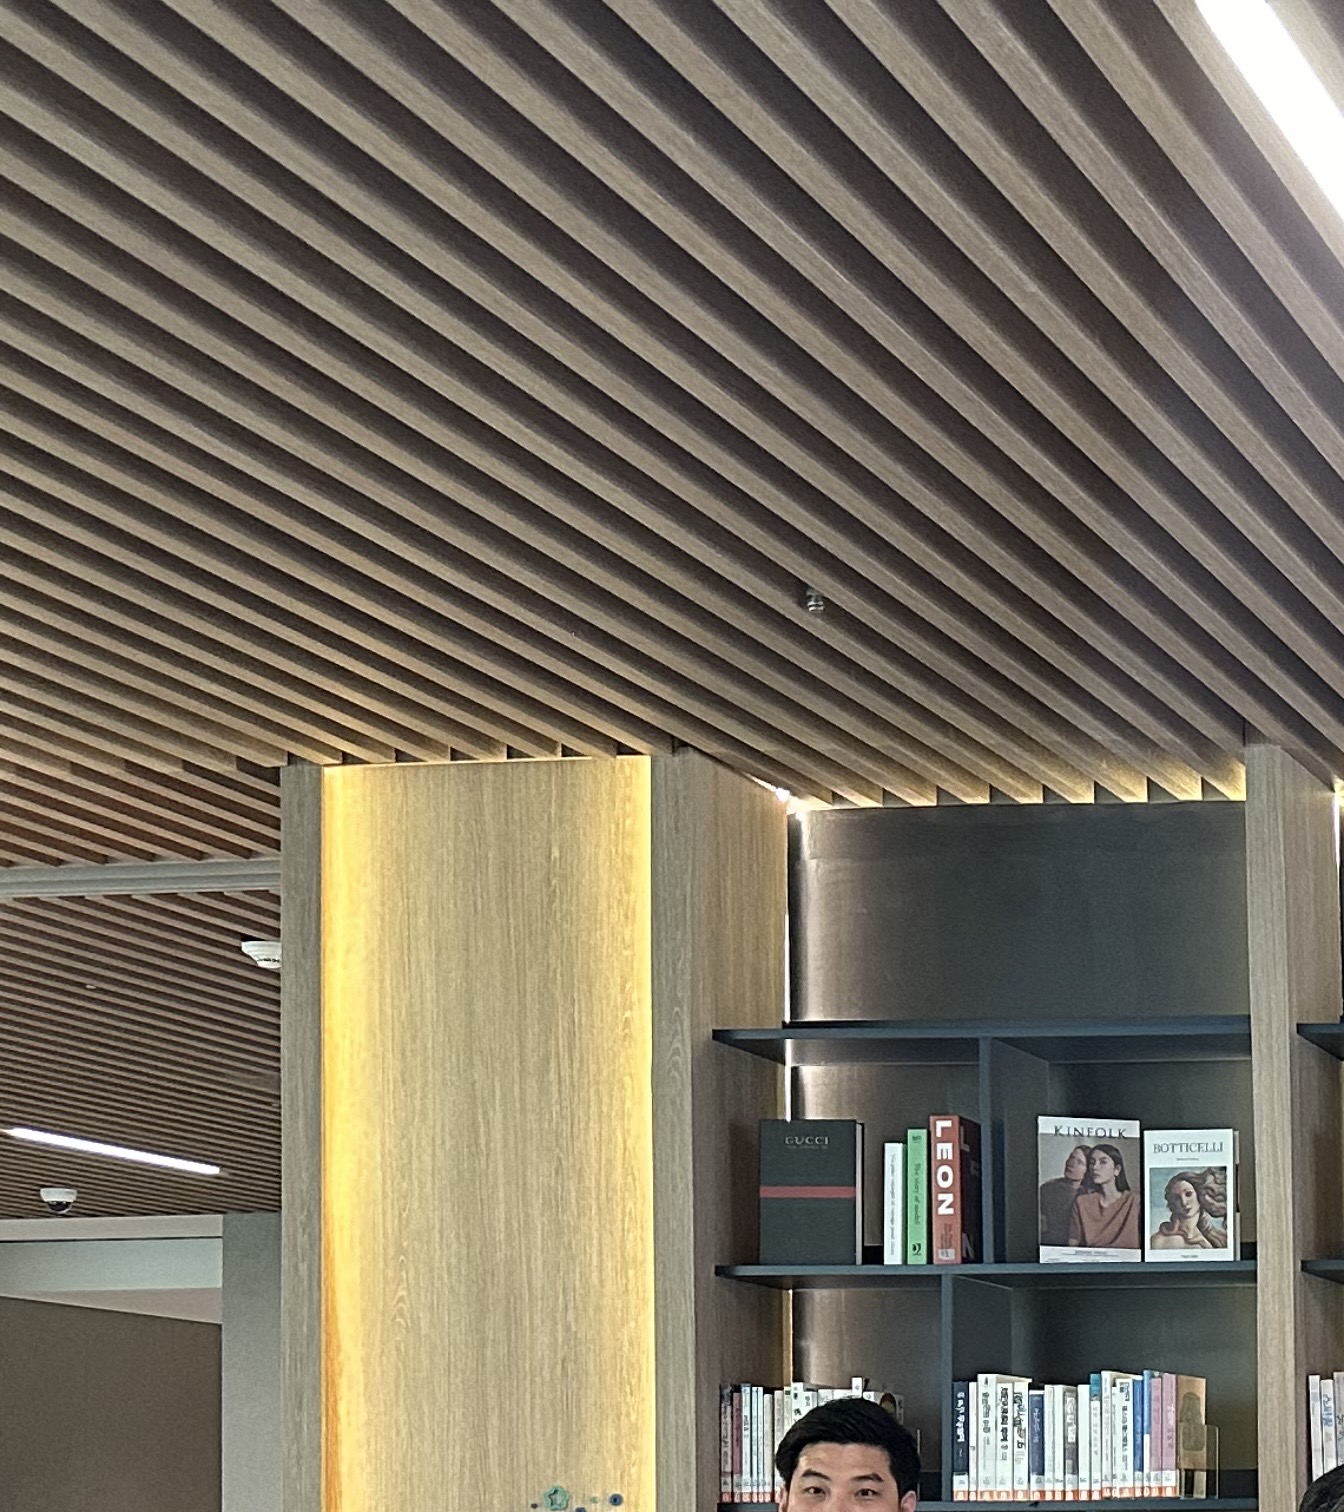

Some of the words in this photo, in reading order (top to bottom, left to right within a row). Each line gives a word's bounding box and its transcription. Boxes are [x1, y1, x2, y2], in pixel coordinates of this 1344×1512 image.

[1054, 1125, 1128, 1140] KINFOLK
[785, 1135, 829, 1145] GUCCI
[1153, 1141, 1224, 1154] BOTTICELLI
[935, 1120, 954, 1215] LEON
